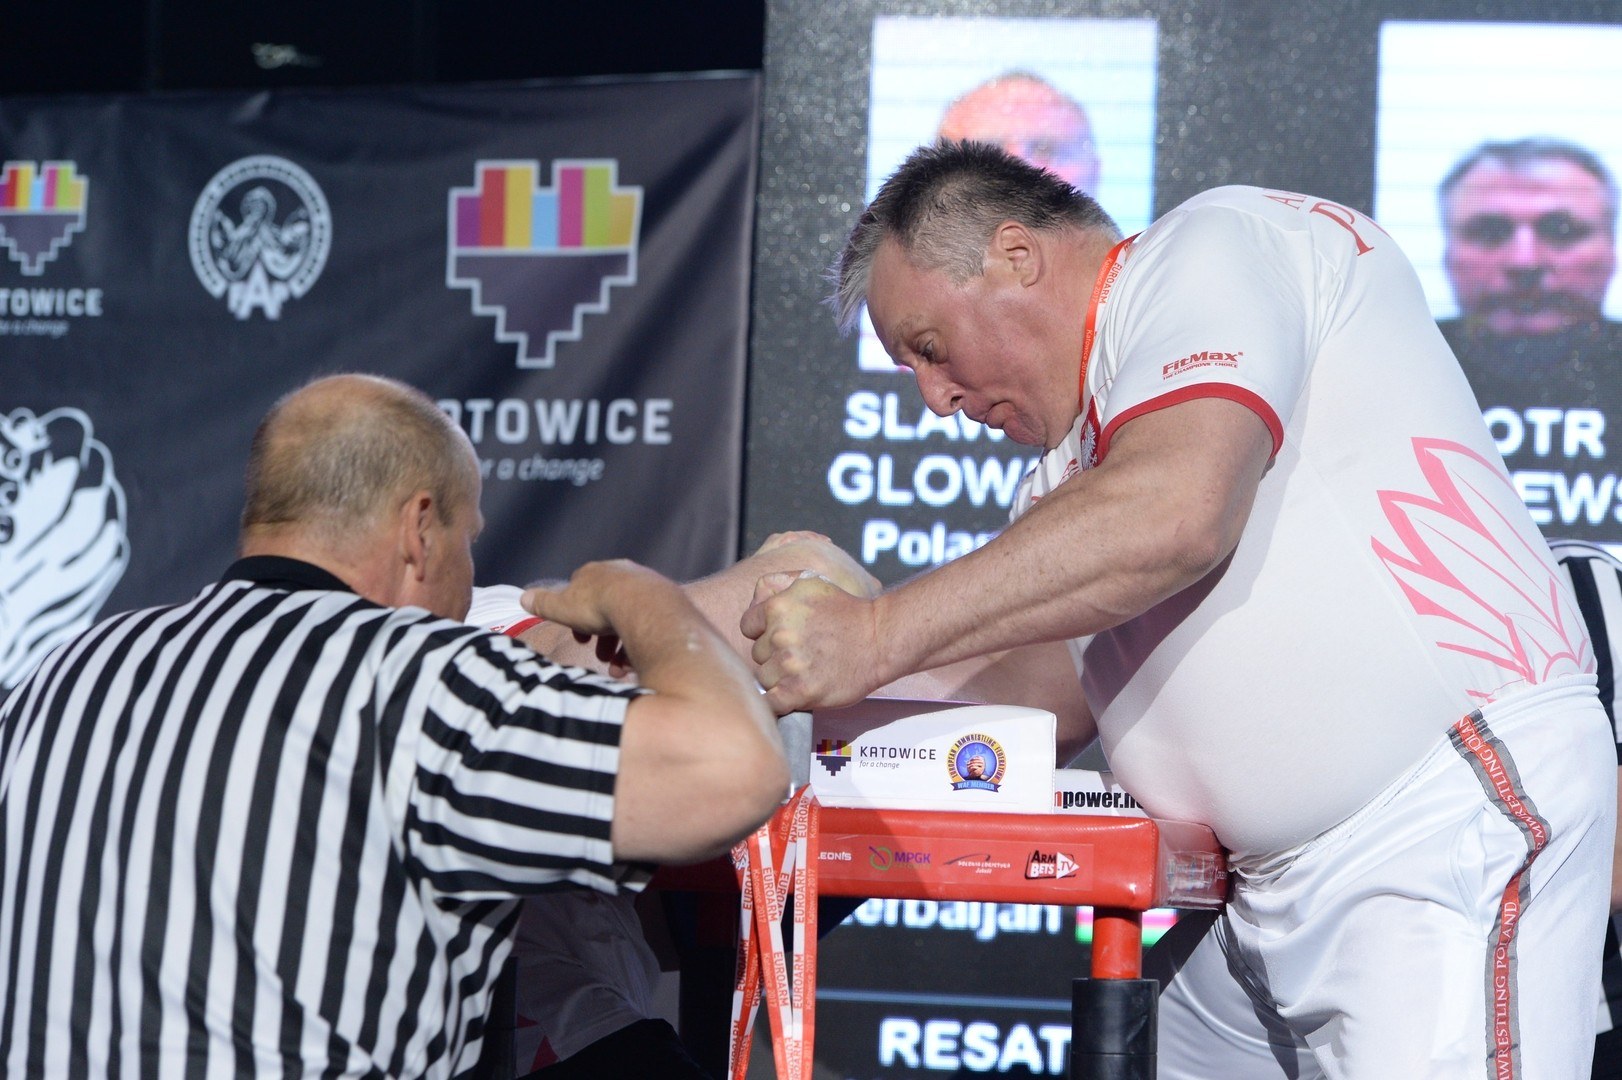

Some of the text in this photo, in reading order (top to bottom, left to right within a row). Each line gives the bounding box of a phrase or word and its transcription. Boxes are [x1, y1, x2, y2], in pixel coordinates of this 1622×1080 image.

[1099, 262, 1122, 304] EUROARM
[0, 287, 104, 317] TOWICE
[1082, 329, 1092, 360] Katowice
[1483, 406, 1606, 458] OTR
[859, 745, 937, 761] KATOWICE
[859, 759, 869, 768] for
[876, 761, 900, 770] change
[894, 851, 931, 864] MPGK
[1030, 862, 1055, 877] BETS
[1031, 850, 1057, 863] ARM
[763, 867, 778, 922] EUROARM
[795, 868, 806, 923] EUROARM
[773, 951, 789, 1007] EUROARM
[793, 954, 804, 1009] EUROARM
[879, 1016, 1072, 1075] RESAT
